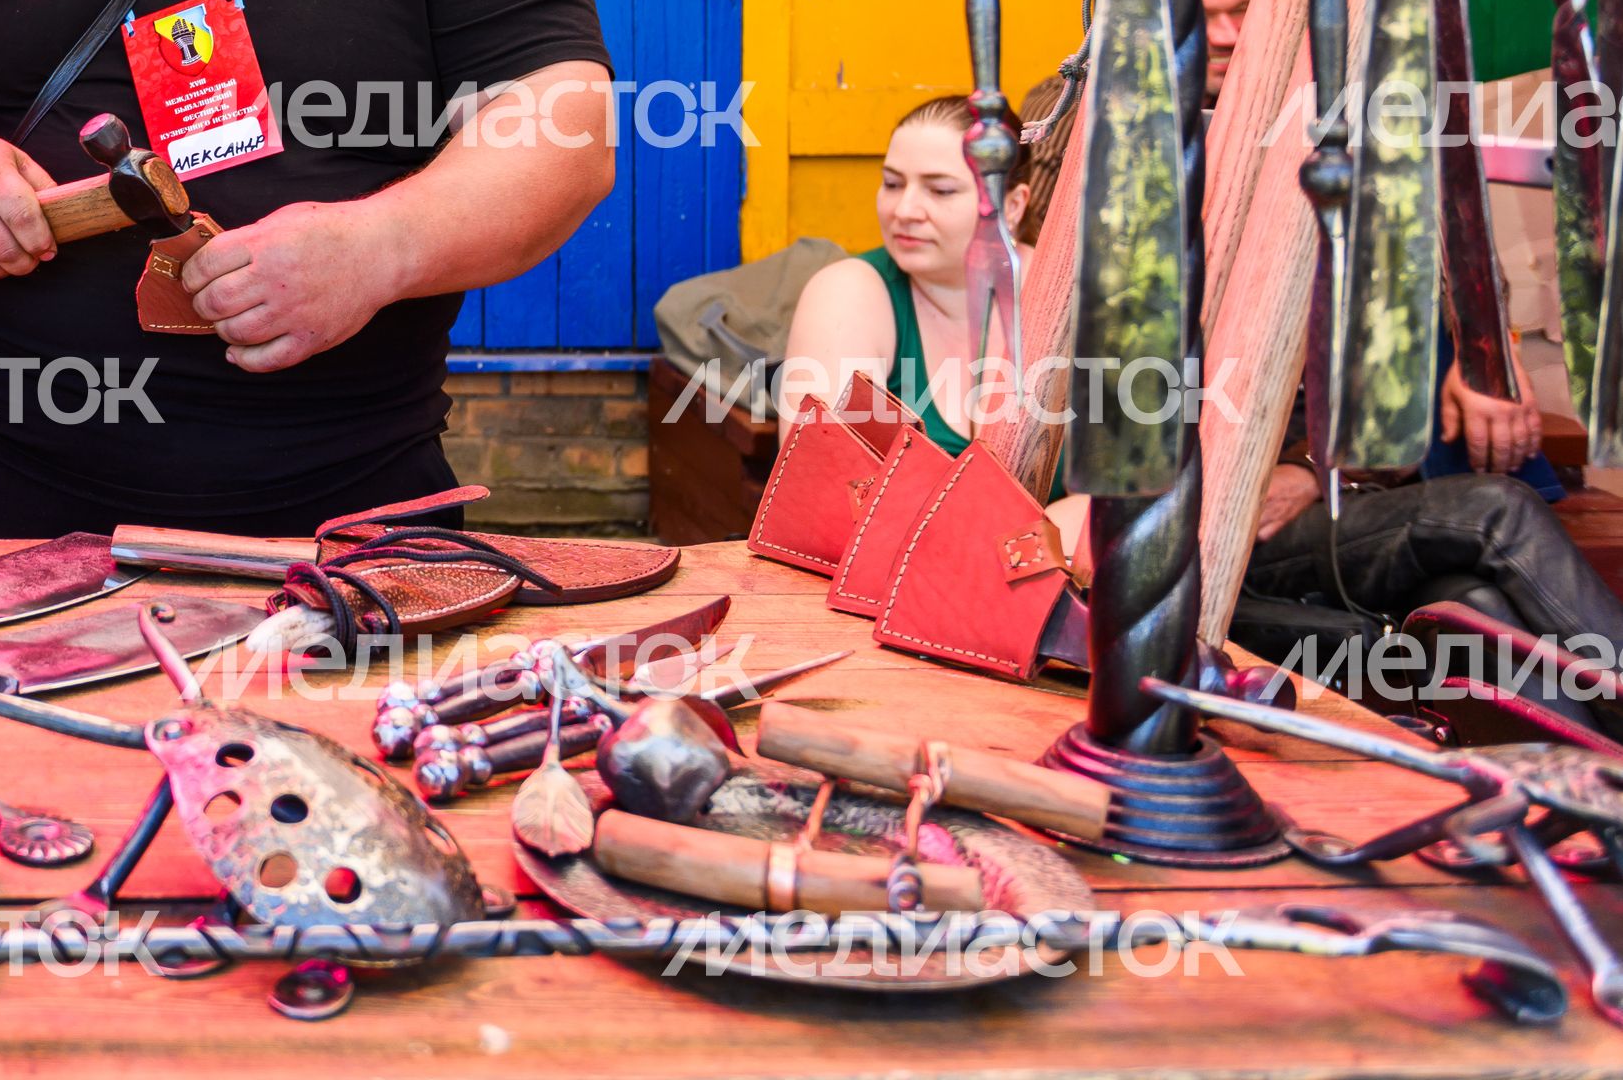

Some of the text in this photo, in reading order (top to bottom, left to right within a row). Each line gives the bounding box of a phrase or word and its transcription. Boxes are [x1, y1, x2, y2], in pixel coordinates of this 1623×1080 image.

[165, 78, 237, 107] МЕЖДУНАРОДНЫЙ
[160, 105, 258, 141] КУЗНЕЧНОГО ИСКУССТВА
[182, 103, 230, 123] ФЕСТИВАЛЬ
[173, 134, 265, 171] АЛЕКСАНДР
